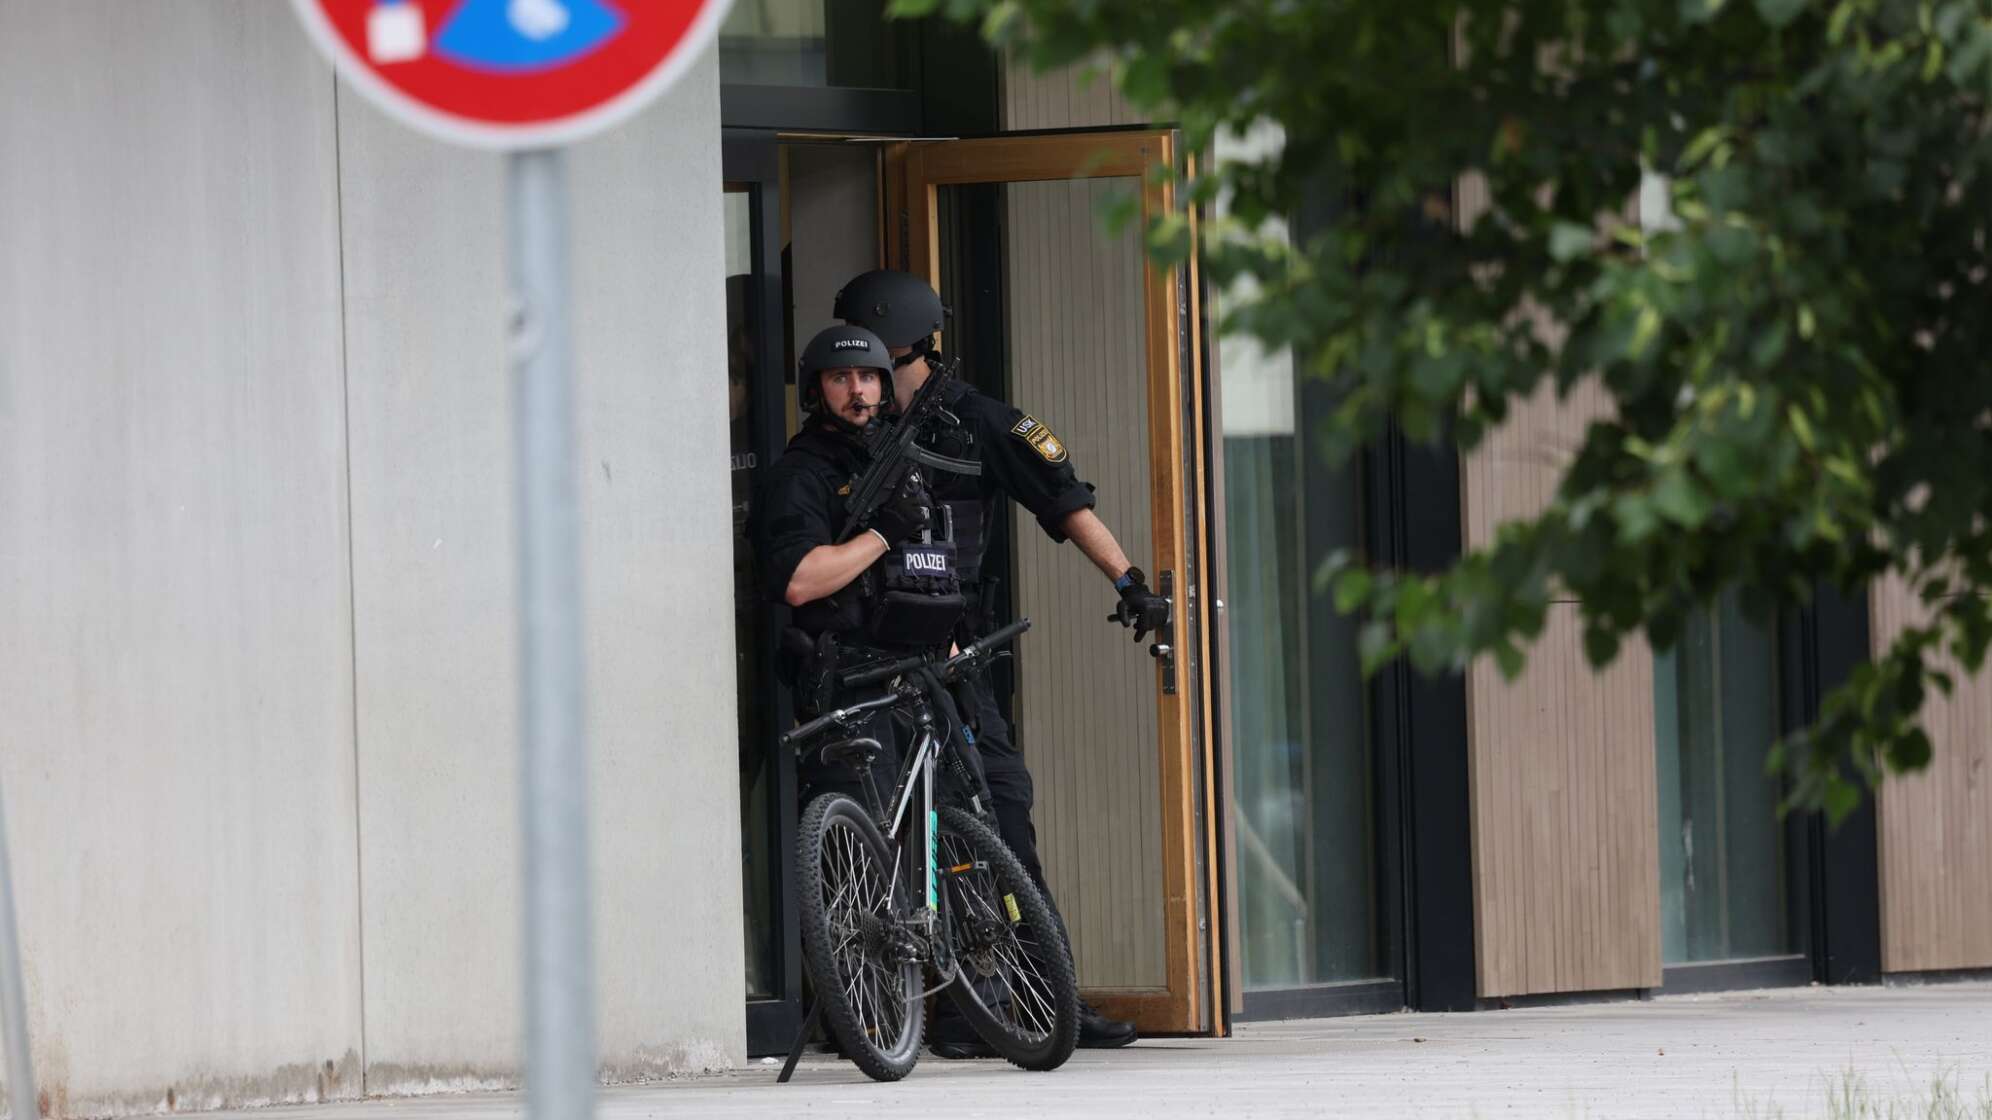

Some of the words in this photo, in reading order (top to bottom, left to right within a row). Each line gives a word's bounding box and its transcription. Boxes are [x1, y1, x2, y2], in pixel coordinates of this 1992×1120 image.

[835, 340, 868, 348] POLIZEI
[1016, 418, 1037, 433] USK
[906, 552, 946, 571] POLIZEI
